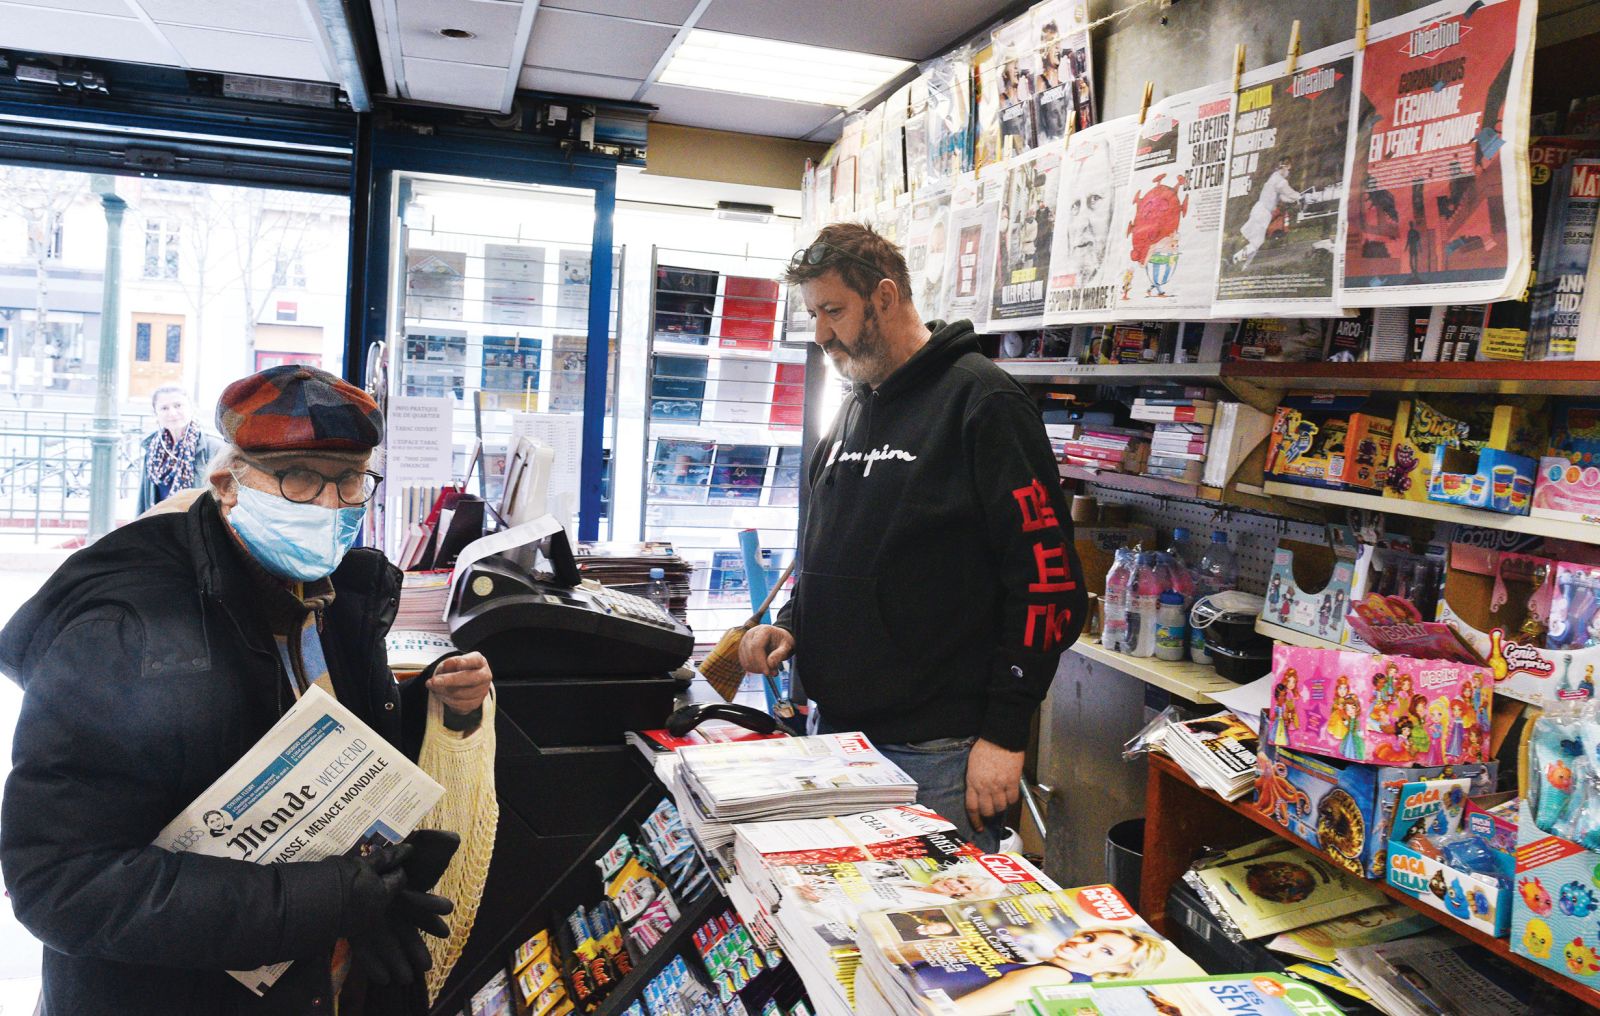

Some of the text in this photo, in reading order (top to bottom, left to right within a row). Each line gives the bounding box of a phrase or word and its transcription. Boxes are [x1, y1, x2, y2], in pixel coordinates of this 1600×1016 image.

[1409, 22, 1461, 58] Libération
[1293, 68, 1336, 98] Libération
[1392, 84, 1464, 127] L'ÉCONOMIE
[1188, 120, 1202, 144] LES
[1203, 114, 1230, 142] PETITS
[1368, 112, 1482, 162] EN TERRE INCONNUE
[1192, 139, 1228, 167] SALAIRES
[1183, 163, 1226, 192] DE LA PEUR
[1553, 293, 1585, 313] HID
[1503, 642, 1539, 660] Genie
[1508, 658, 1552, 672] Surprise
[226, 738, 368, 862] Monde WEEK-END
[305, 801, 346, 837] MENACE
[344, 757, 389, 804] MONDIALE
[1403, 802, 1441, 819] RELAX
[1405, 789, 1441, 808] CACA
[979, 854, 1025, 882] Gala
[1391, 855, 1426, 876] CACA
[1391, 870, 1431, 893] RELAX
[1081, 889, 1119, 919] DE VUE
[1096, 887, 1133, 918] POINT
[958, 921, 1007, 964] L'HISTOIRE
[970, 914, 992, 937] Juan
[987, 936, 1015, 960] Carlos
[958, 940, 1002, 978] D'AMOUR
[1238, 984, 1265, 1006] LES
